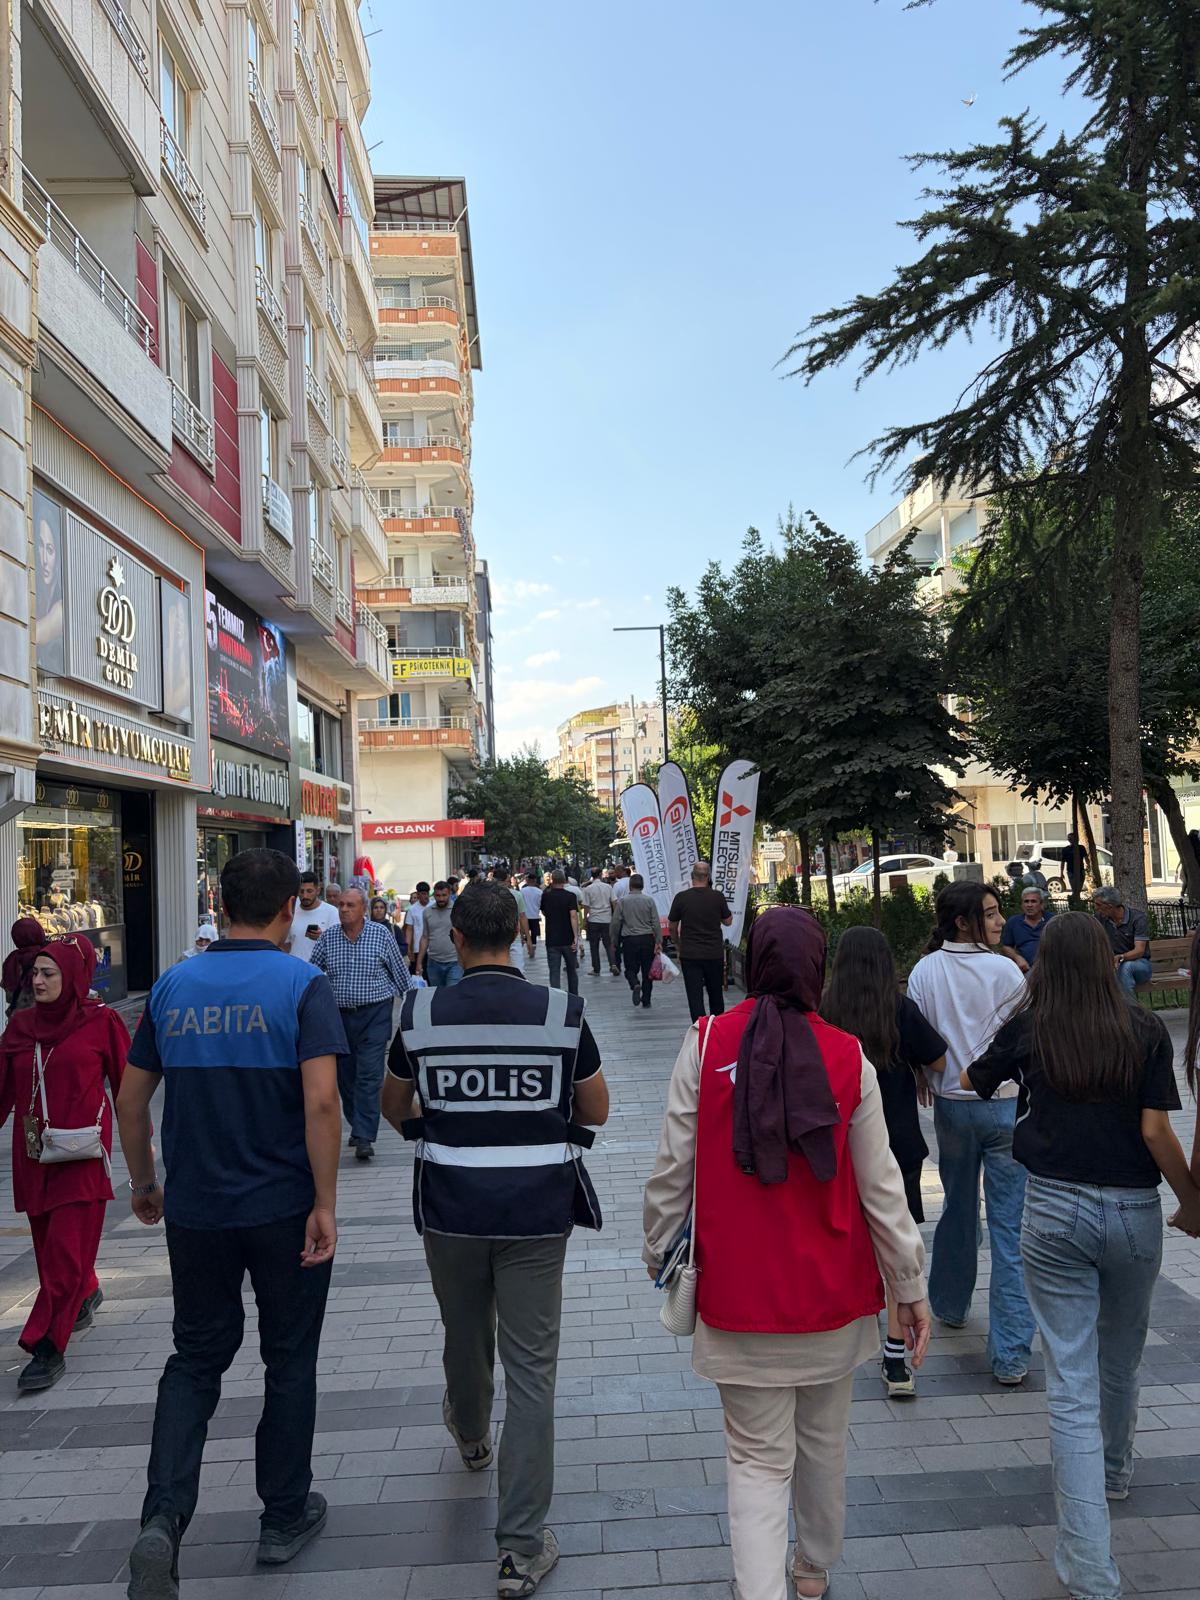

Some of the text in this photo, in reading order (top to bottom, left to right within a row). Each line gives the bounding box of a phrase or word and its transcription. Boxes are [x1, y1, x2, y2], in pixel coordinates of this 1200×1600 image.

[217, 602, 246, 643] TEMMUZ
[98, 636, 138, 672] DEMİR
[104, 664, 133, 689] GOLD
[93, 719, 192, 772] KUYUMCULUK
[249, 762, 290, 811] teknoloji
[374, 824, 436, 835] AKBANK
[715, 830, 729, 893] ELECTRIC
[726, 831, 741, 903] MITSUBISHI
[165, 1004, 269, 1038] ZABITA
